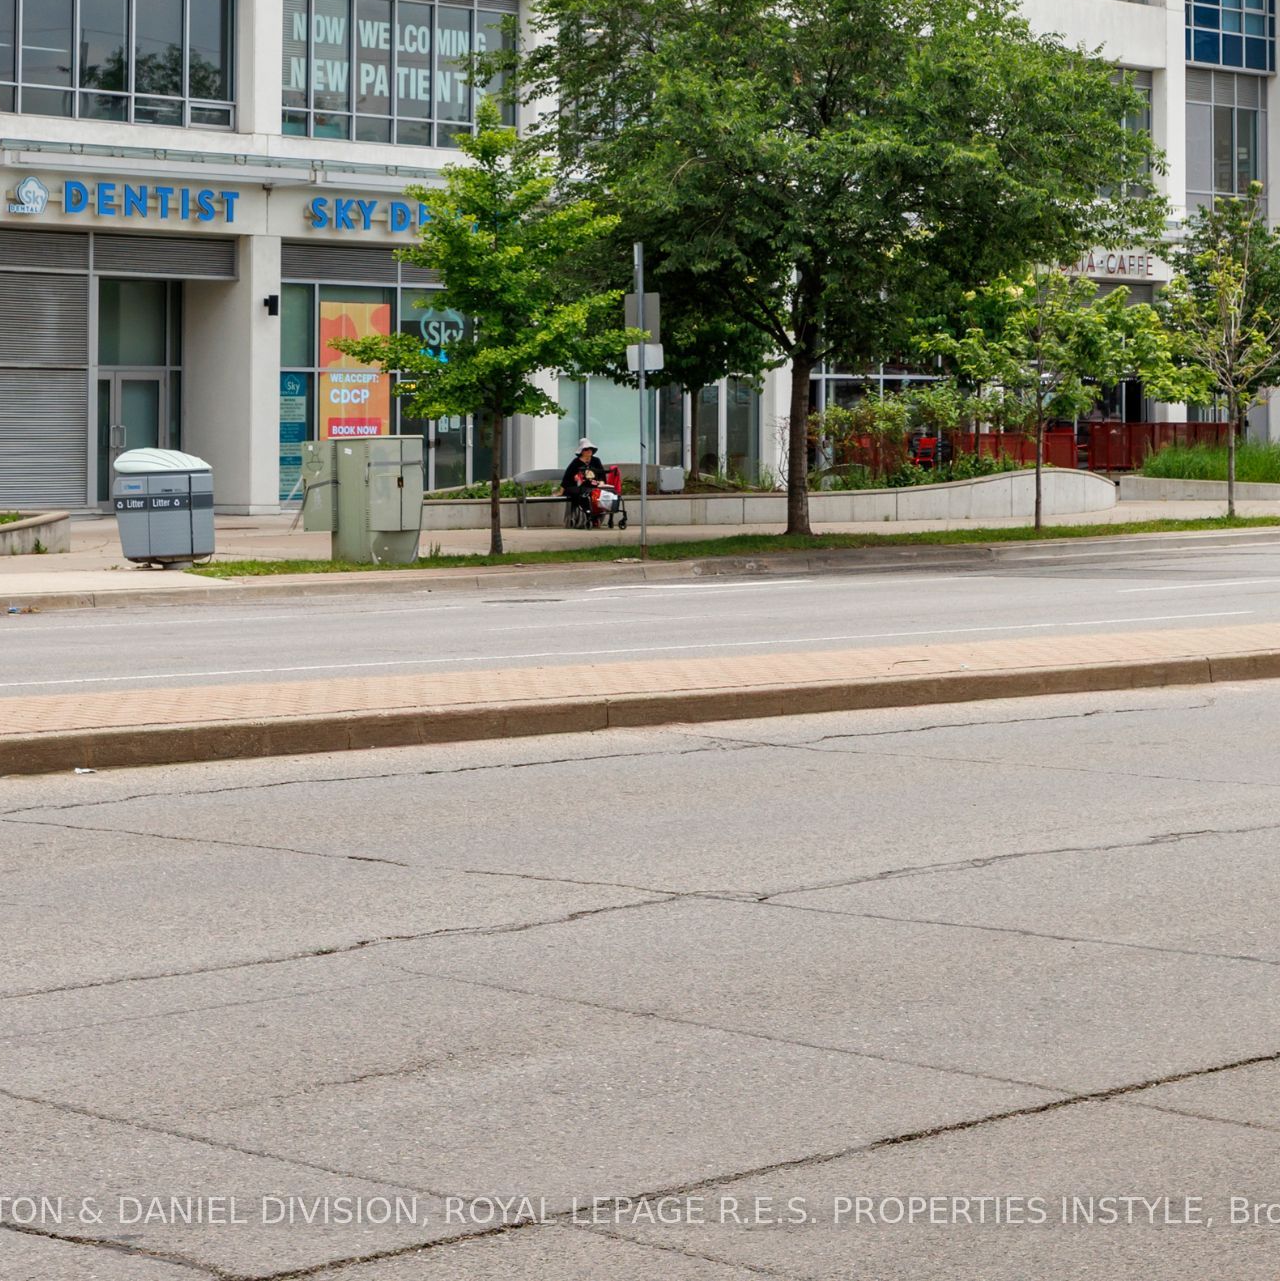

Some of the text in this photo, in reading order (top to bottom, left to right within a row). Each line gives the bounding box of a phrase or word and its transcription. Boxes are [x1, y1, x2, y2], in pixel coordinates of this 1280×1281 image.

[293, 12, 487, 58] NOW WELCOMING
[291, 56, 348, 93] NEW
[63, 180, 240, 223] DENTIST
[10, 204, 38, 213] DENTAL
[311, 196, 377, 231] SKY
[330, 373, 379, 383] WE ACCEPT:
[329, 388, 370, 404] CDCP
[332, 425, 377, 435] BOOK NOW
[127, 499, 144, 508] Litter
[152, 498, 170, 507] Litter
